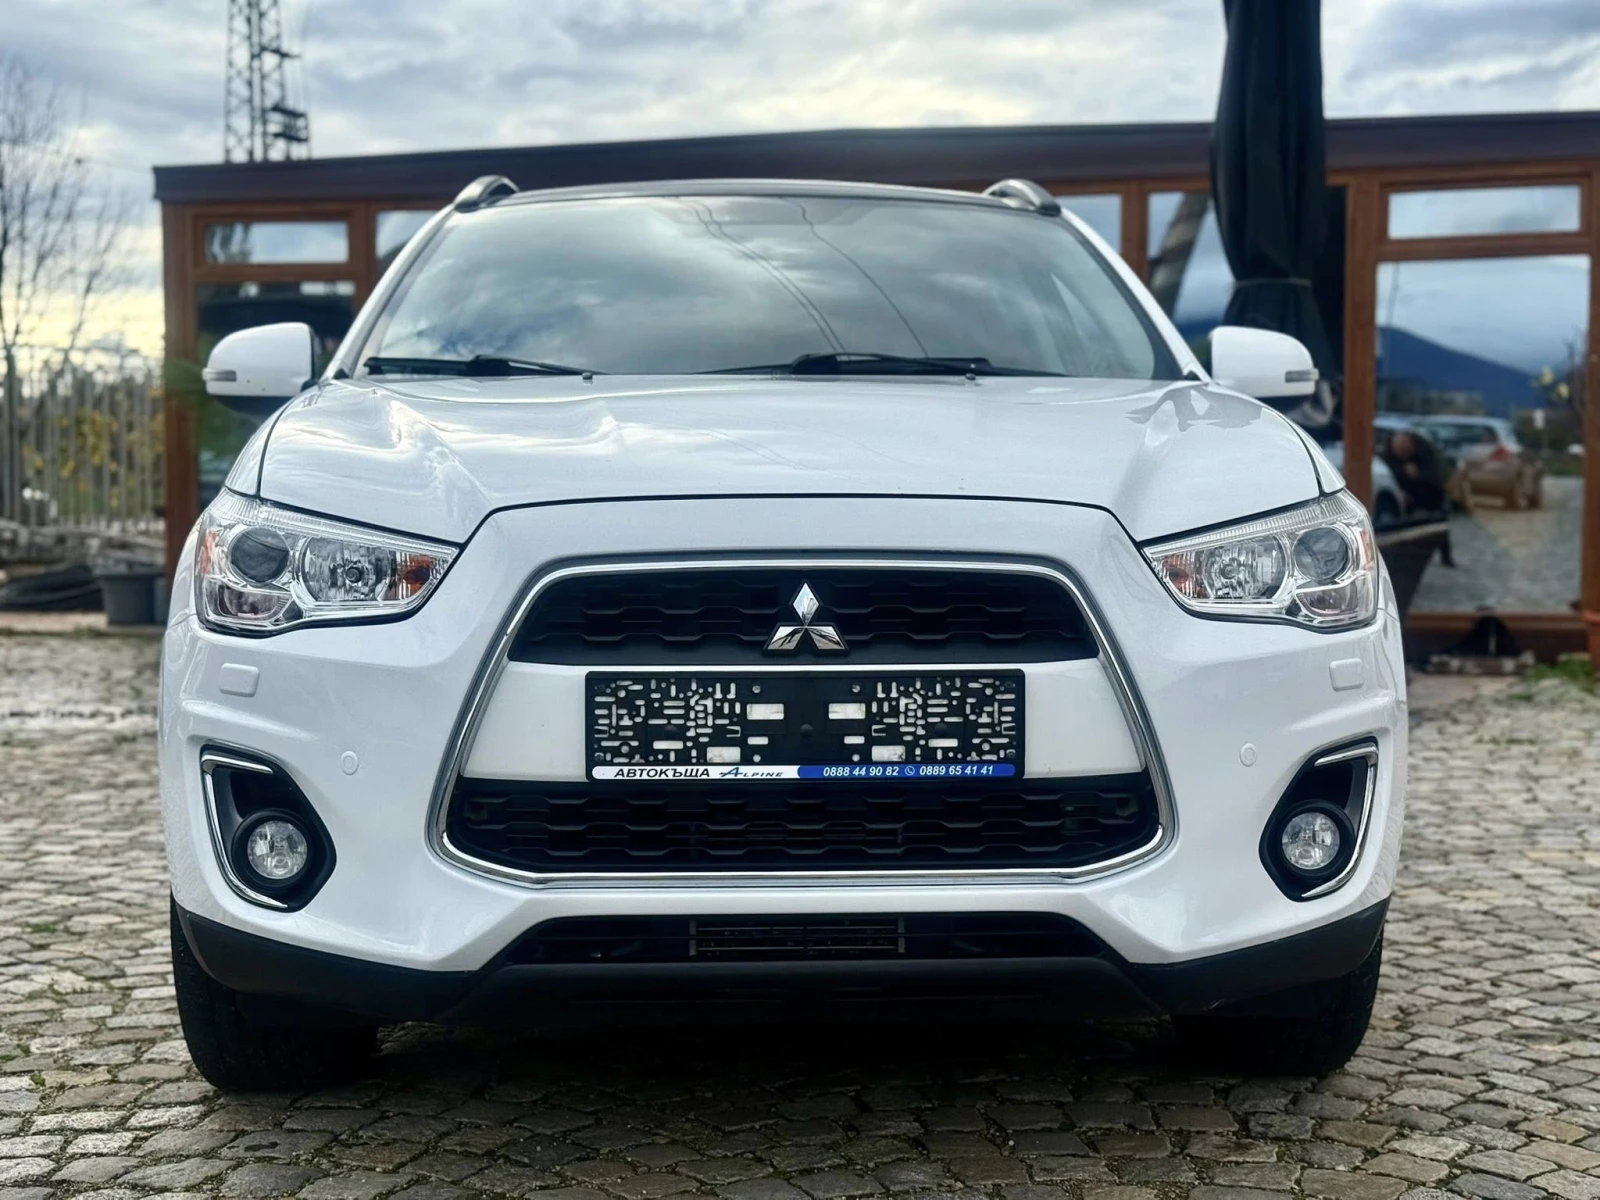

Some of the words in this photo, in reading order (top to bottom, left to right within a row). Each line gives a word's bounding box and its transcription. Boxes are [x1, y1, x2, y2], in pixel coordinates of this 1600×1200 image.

[822, 766, 850, 777] 0888
[852, 766, 867, 777] 44
[869, 766, 883, 776] 90
[885, 766, 900, 776] 82
[919, 765, 946, 776] 0889
[948, 765, 963, 776] 65
[964, 765, 978, 775] 41
[980, 765, 994, 775] 41
